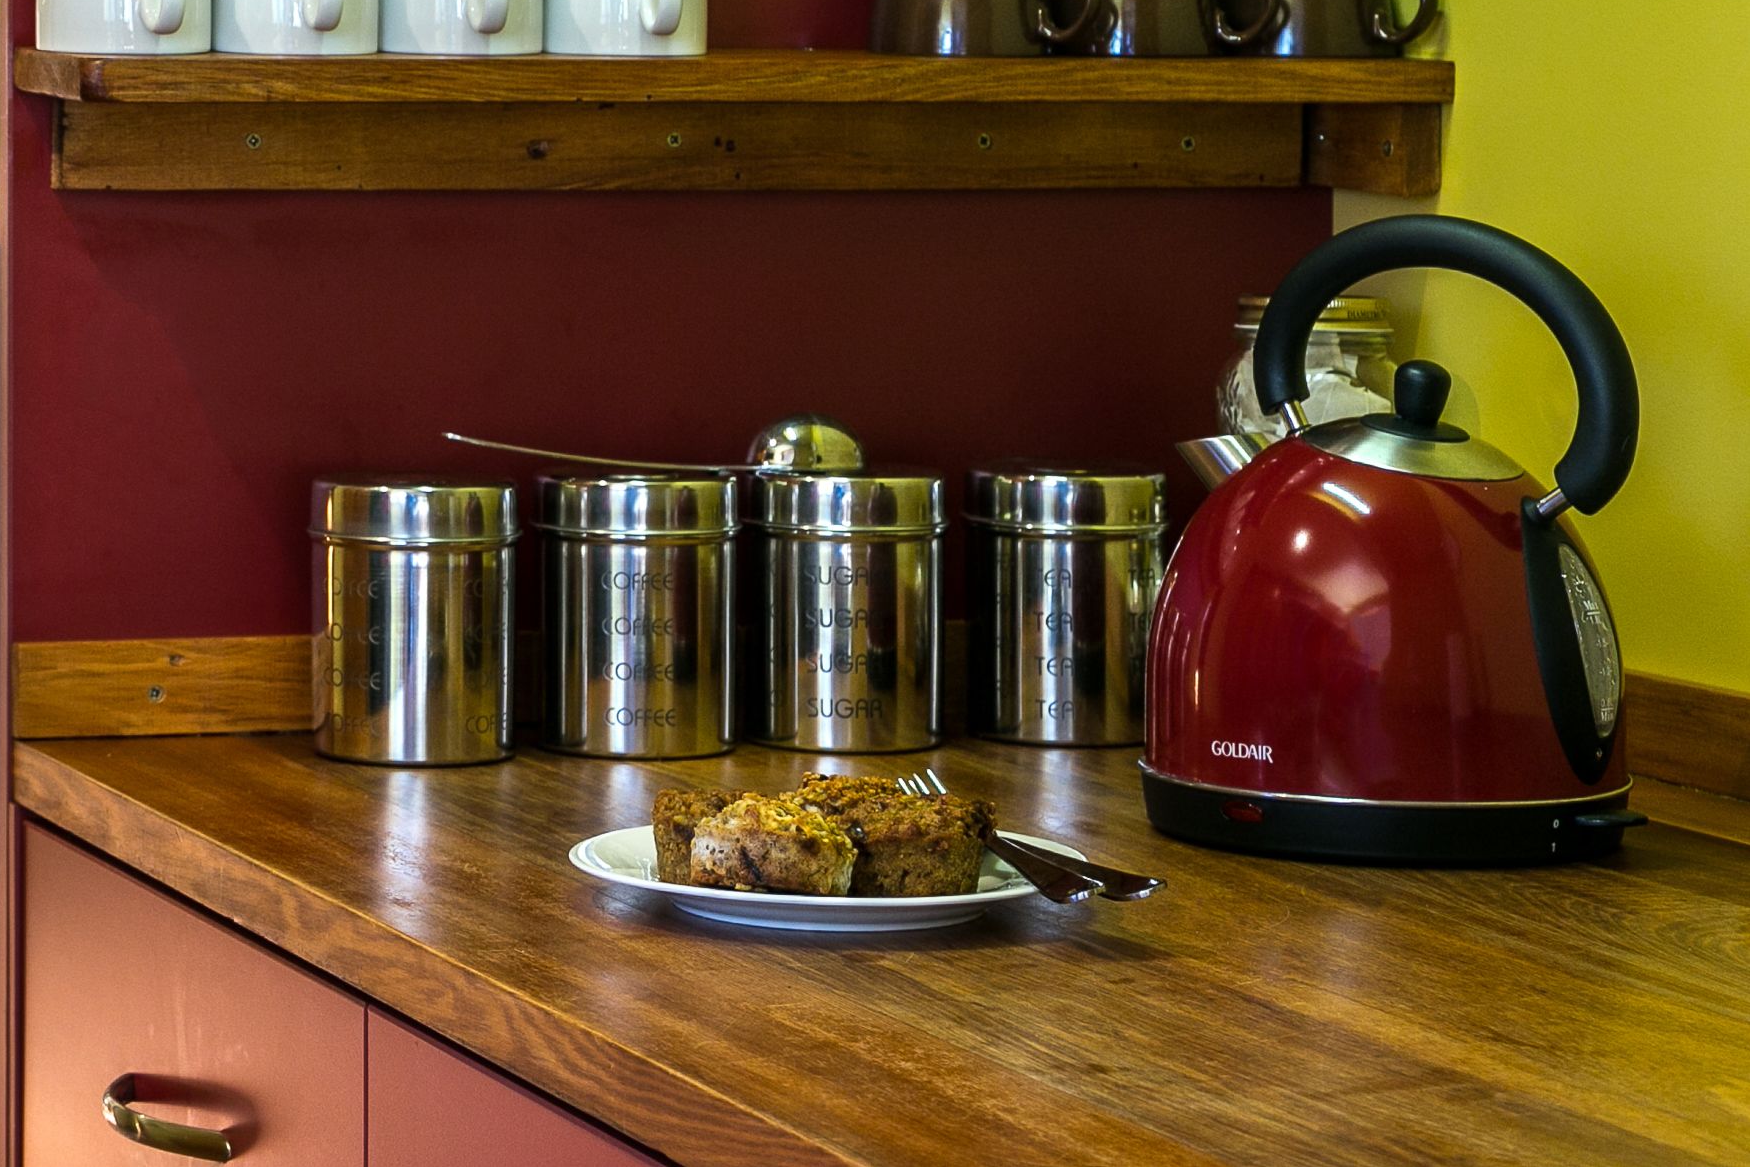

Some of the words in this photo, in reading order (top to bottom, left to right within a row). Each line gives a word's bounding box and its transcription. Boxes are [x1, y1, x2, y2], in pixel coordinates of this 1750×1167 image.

[601, 571, 674, 591] COFFEE
[804, 566, 871, 586] SUGA
[1035, 568, 1072, 588] EA
[805, 608, 871, 628] SUGA
[1033, 612, 1074, 632] TEA
[805, 653, 871, 674] SUGA
[1034, 655, 1074, 676] TEA
[605, 707, 677, 727] COFFEE
[807, 697, 883, 719] SUGAR
[1034, 698, 1075, 720] TEA
[1211, 740, 1274, 764] GOLDAIR
